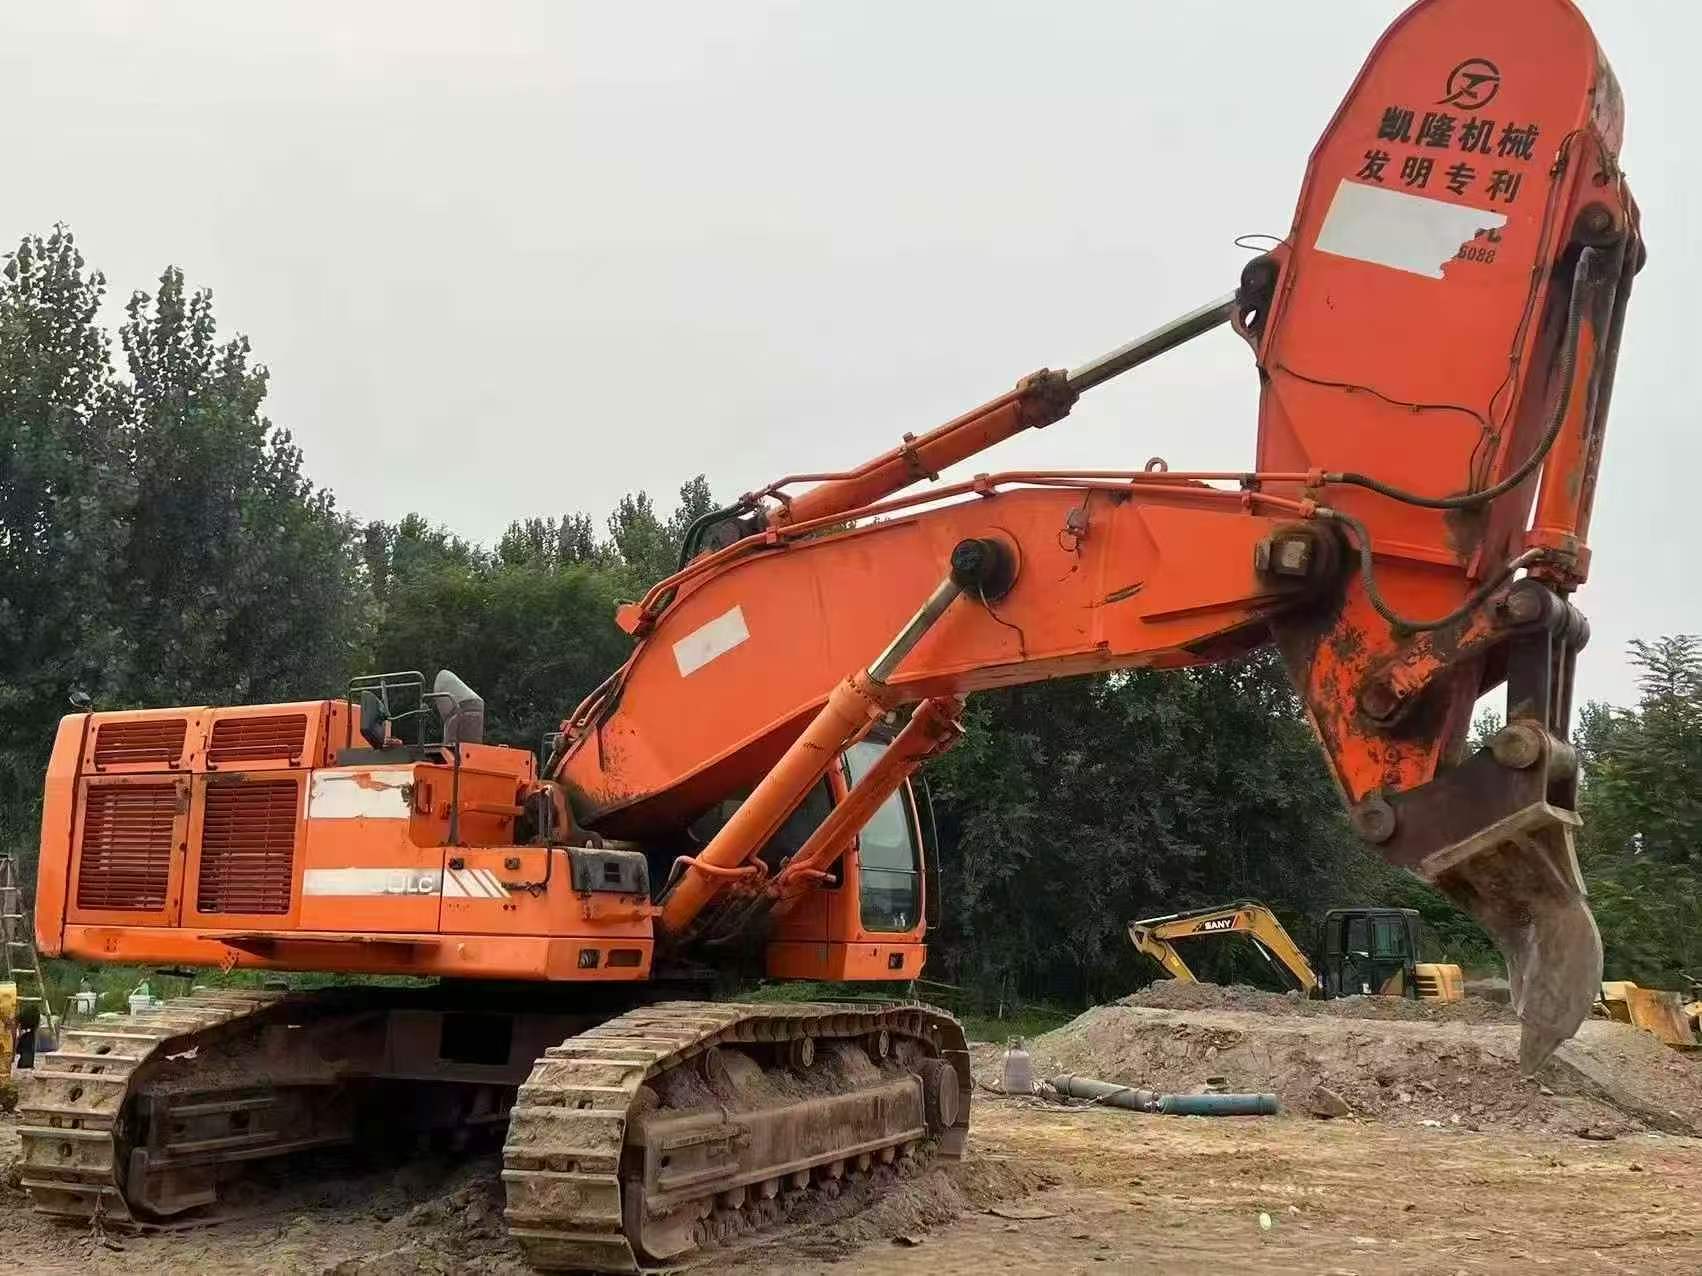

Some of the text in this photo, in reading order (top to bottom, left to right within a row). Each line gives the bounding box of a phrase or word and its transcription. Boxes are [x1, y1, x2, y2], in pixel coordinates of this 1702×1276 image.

[1378, 106, 1540, 161] 凯隆机械
[1356, 150, 1522, 203] 发明专利
[1205, 919, 1231, 930] SANY
